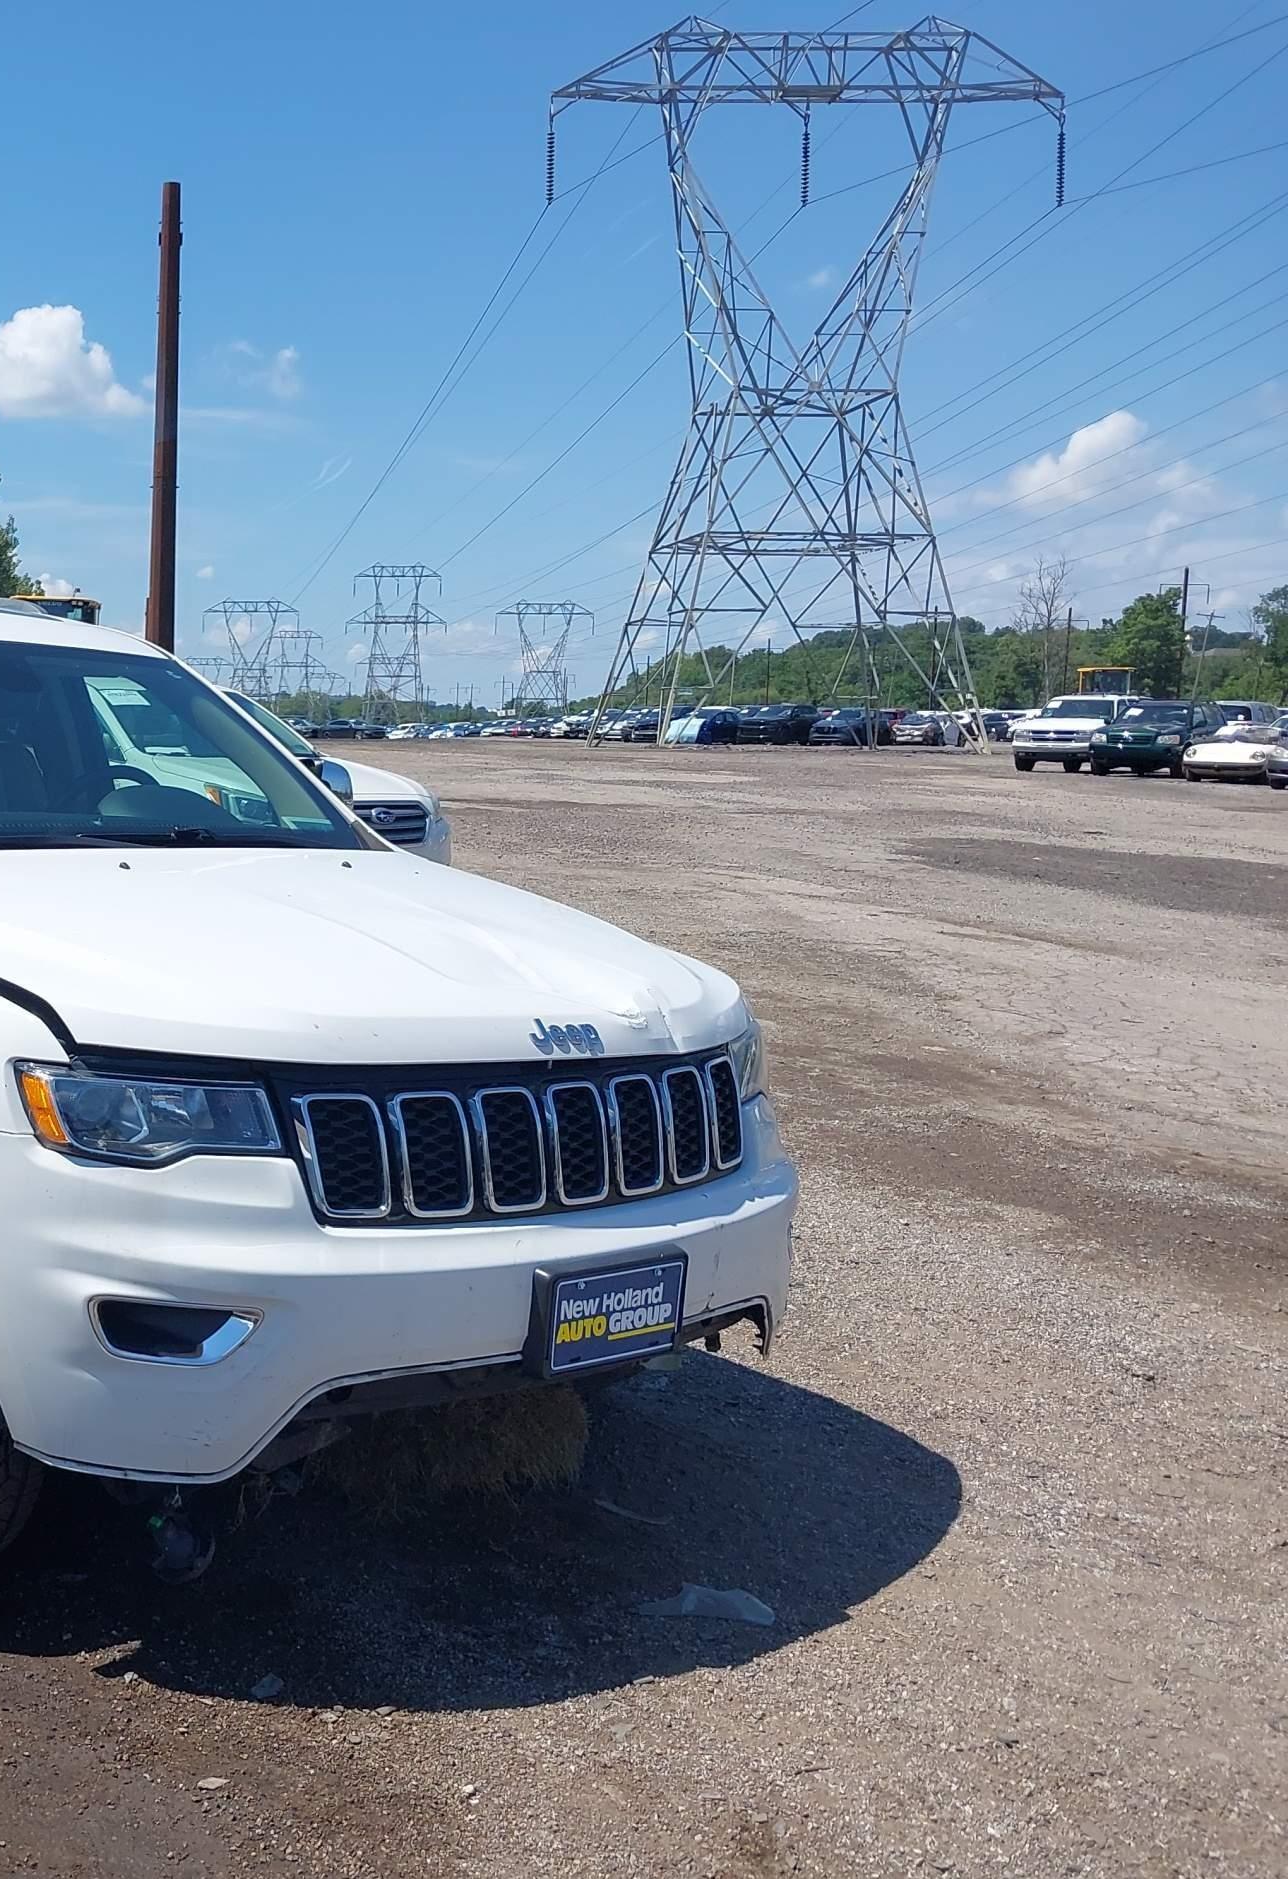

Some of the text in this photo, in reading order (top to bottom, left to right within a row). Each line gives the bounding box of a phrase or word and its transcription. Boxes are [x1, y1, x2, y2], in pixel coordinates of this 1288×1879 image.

[529, 1017, 605, 1056] Jeep
[561, 1282, 664, 1321] New Holland
[556, 1303, 673, 1344] AUTO GROUP
